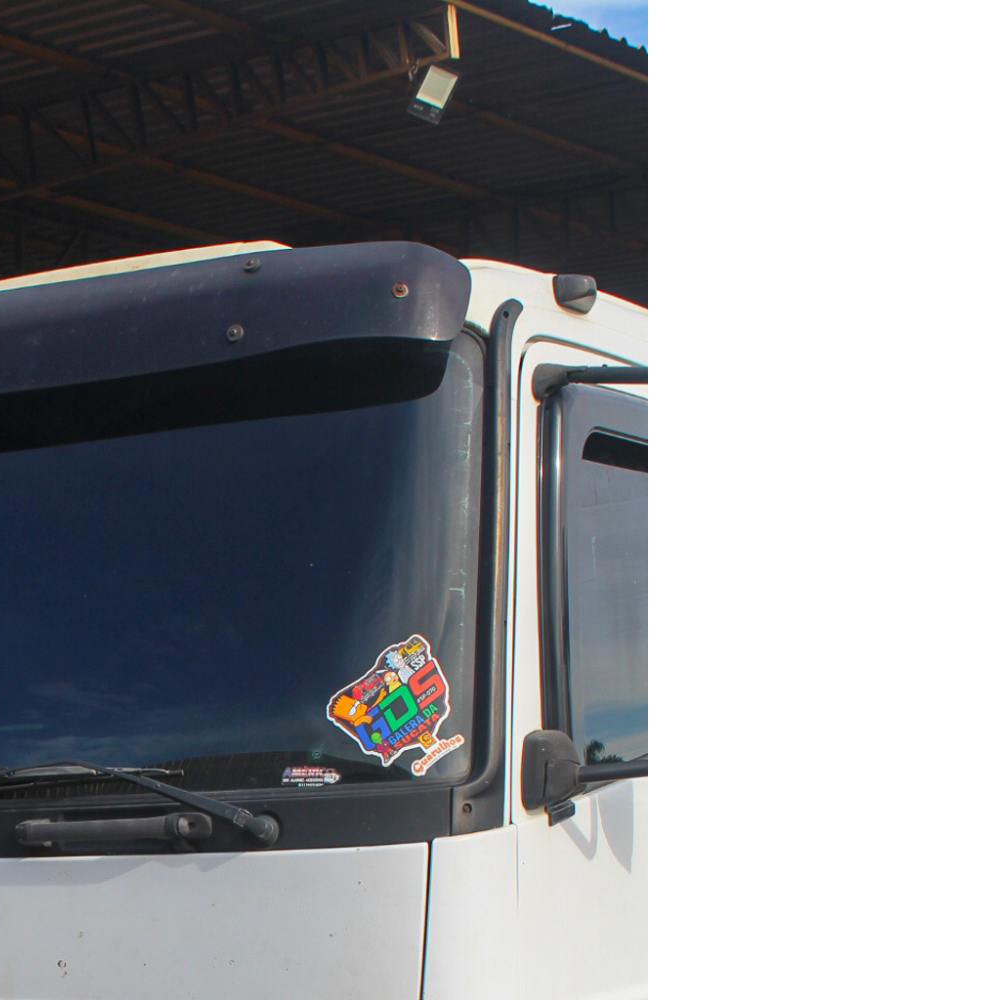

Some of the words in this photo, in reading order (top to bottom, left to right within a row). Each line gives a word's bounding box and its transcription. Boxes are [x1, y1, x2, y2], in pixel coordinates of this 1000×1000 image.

[411, 654, 427, 671] SSP
[355, 660, 446, 750] GDS
[388, 715, 424, 745] GALERA
[422, 704, 438, 718] DA
[395, 713, 440, 749] SUCATA
[412, 736, 462, 773] Guarulhos
